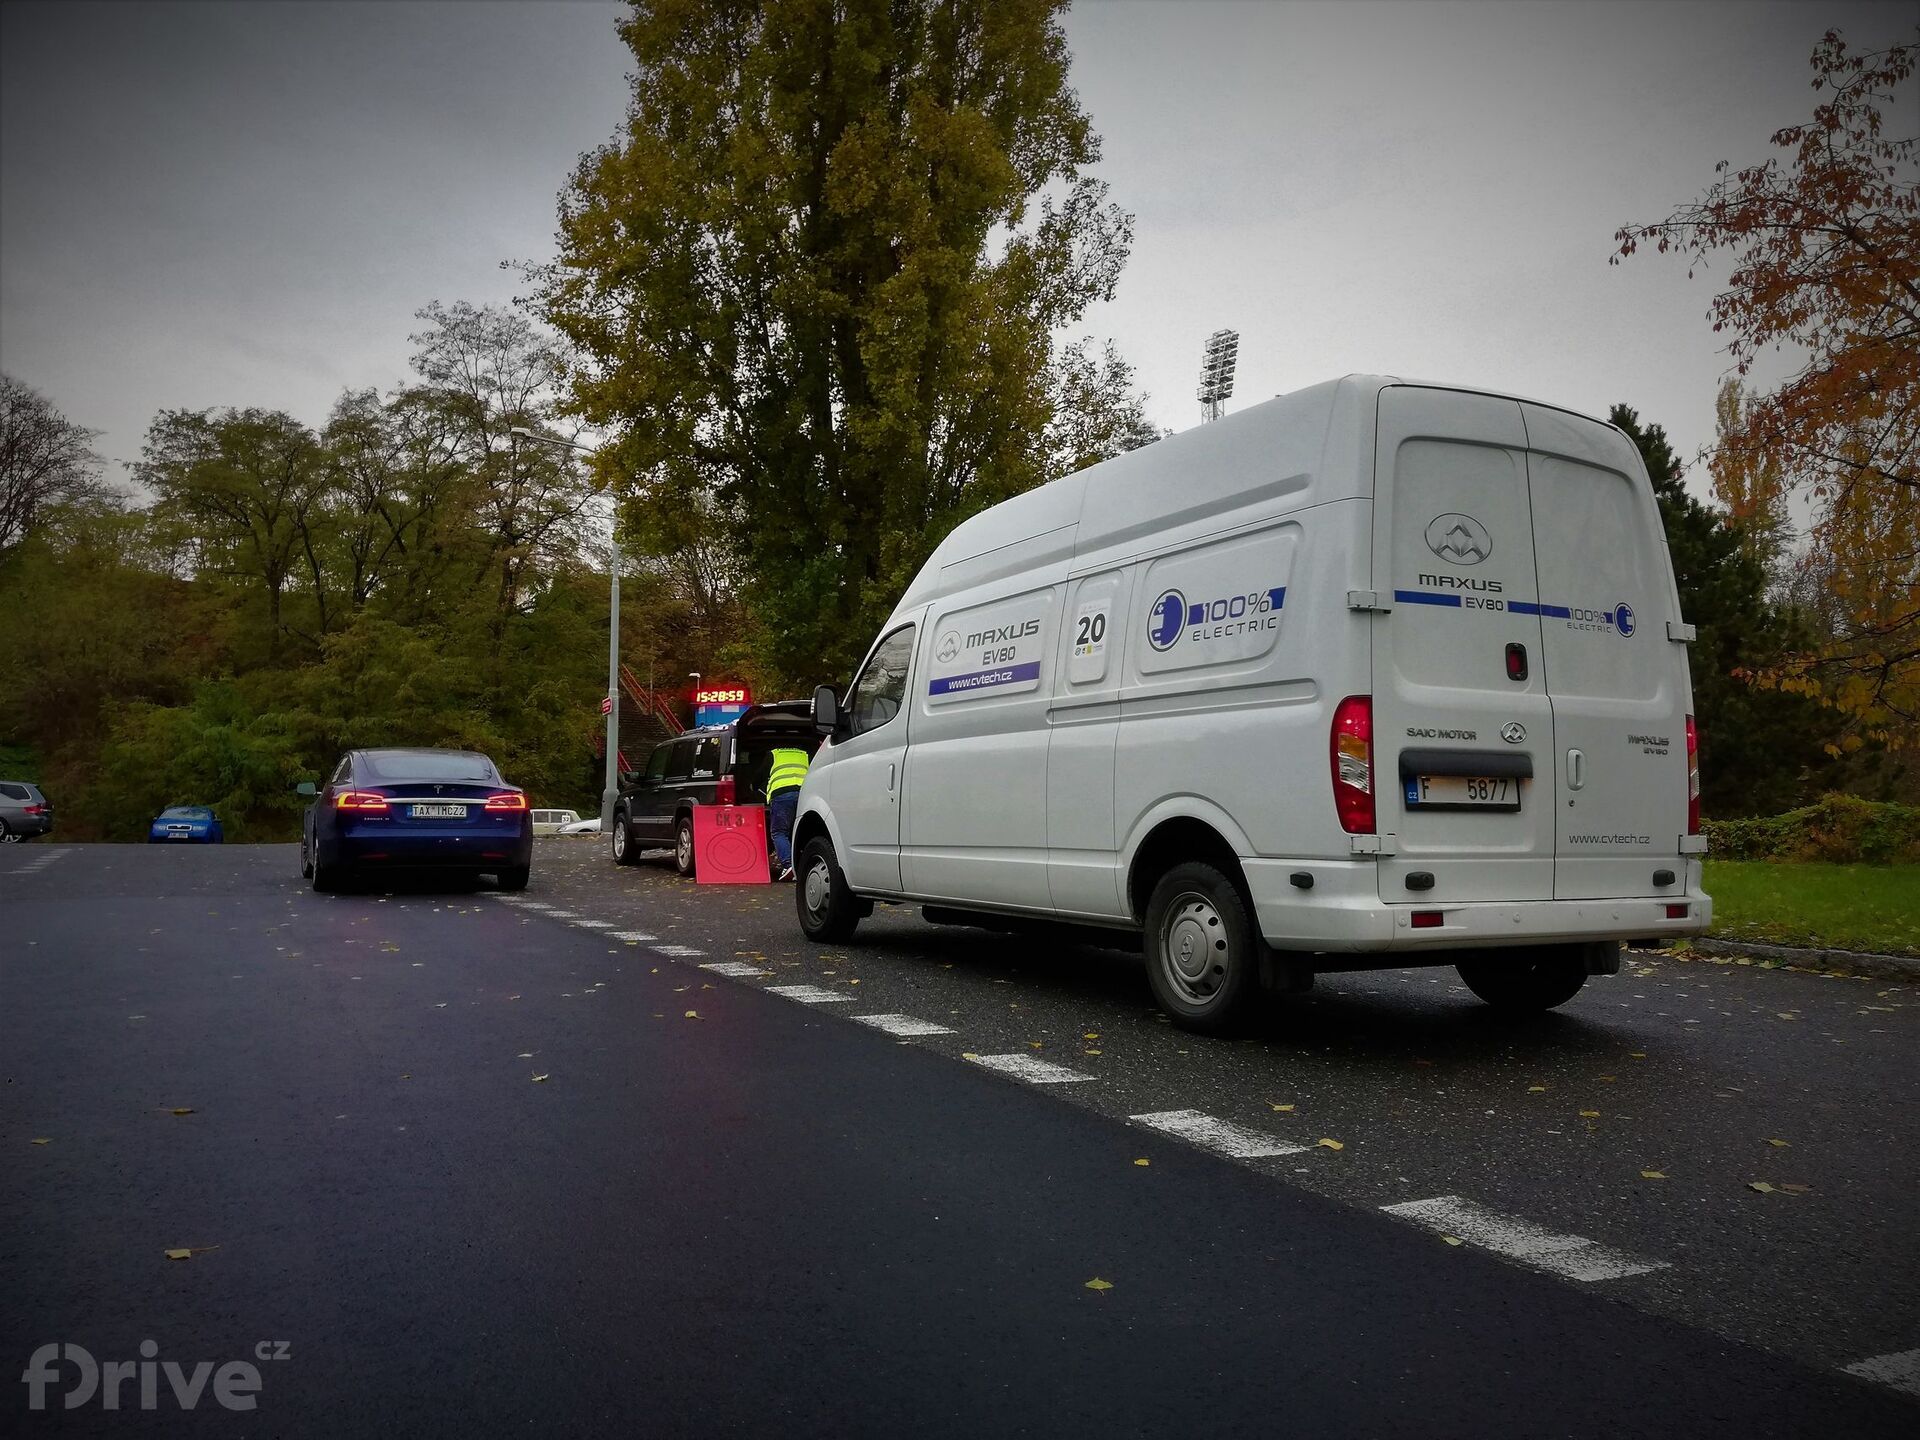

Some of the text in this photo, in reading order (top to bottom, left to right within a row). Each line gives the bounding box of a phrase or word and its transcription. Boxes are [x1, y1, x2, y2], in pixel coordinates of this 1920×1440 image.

[1419, 573, 1503, 593] MAXUS
[1204, 590, 1270, 624] 100%
[1465, 597, 1504, 611] EV80
[1569, 607, 1607, 624] 100%
[966, 619, 1040, 649] MAXUS
[1076, 612, 1106, 646] 20
[1192, 616, 1277, 642] ELECTRIC
[1566, 621, 1612, 634] ELECTRIC
[982, 645, 1016, 666] EV80
[948, 670, 1013, 690] www.cvtech.cz
[696, 690, 745, 703] 15:28:59
[1406, 727, 1477, 741] SAIC MOTOR
[1420, 777, 1508, 801] F 5877
[413, 805, 431, 816] TAX
[1568, 833, 1651, 845] www.cvtech.cz
